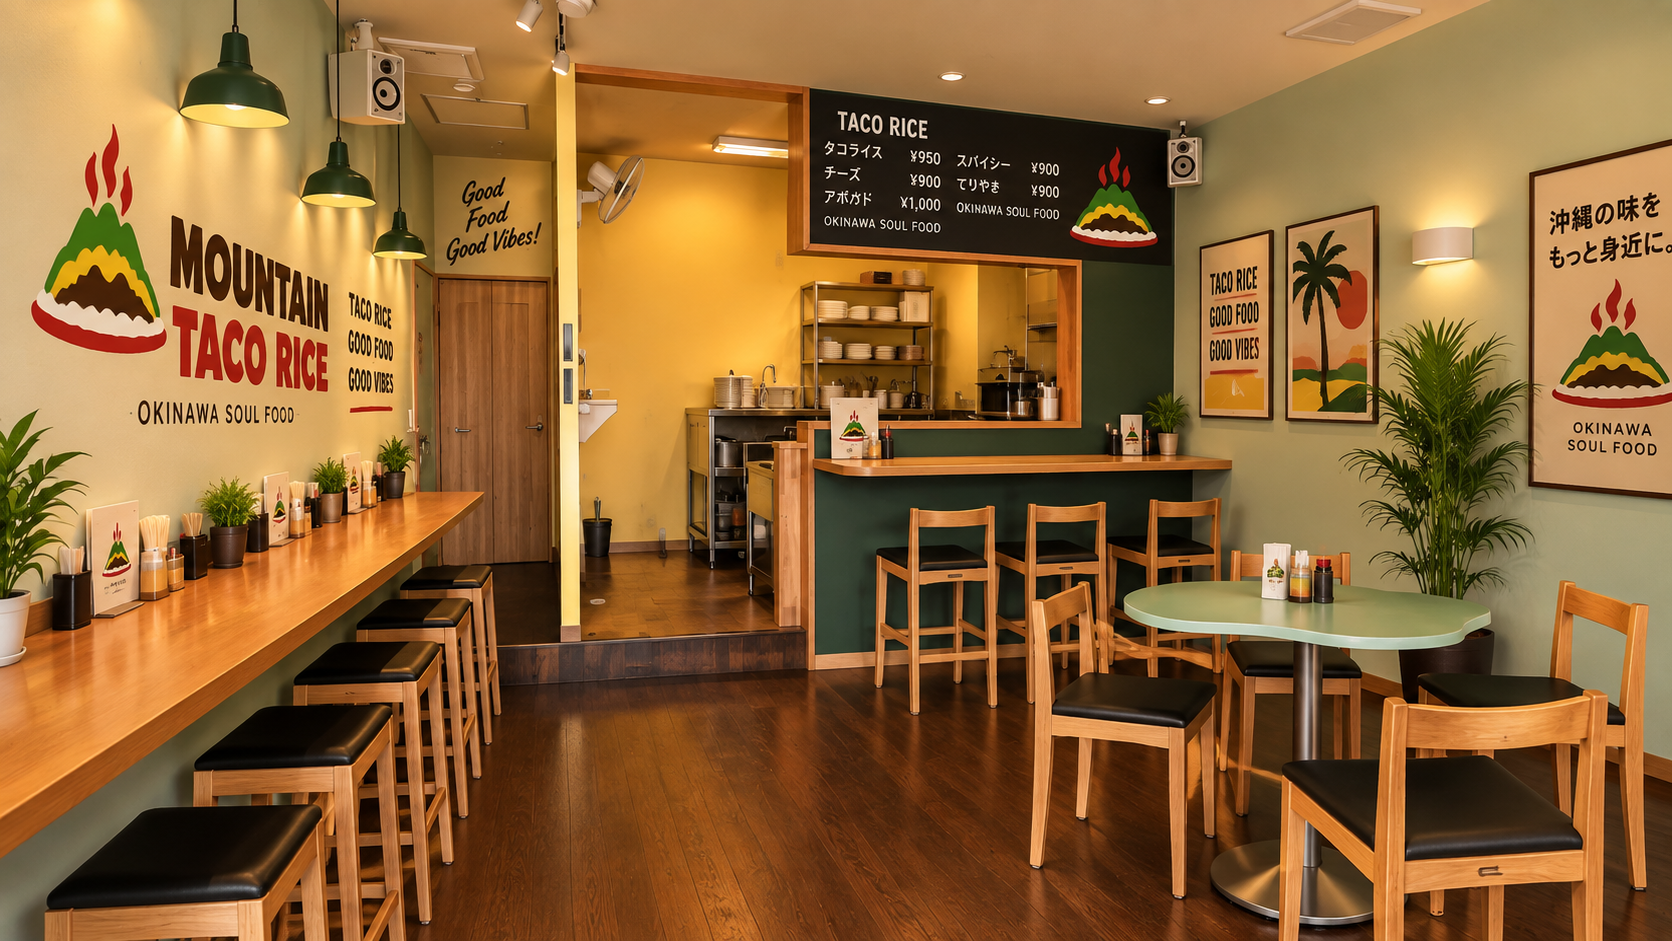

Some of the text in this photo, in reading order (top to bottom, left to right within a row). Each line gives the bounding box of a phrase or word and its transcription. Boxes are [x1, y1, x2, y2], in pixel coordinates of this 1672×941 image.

[837, 110, 929, 140] TACO RICE
[824, 140, 942, 166] タコライス ¥950
[824, 165, 942, 189] チーズ ¥900
[1030, 161, 1061, 177] ¥900
[461, 176, 506, 208] Good
[955, 177, 1061, 199] てりやき ¥900
[465, 200, 510, 234] Food
[899, 196, 942, 213] ¥1,000
[955, 201, 1061, 220] OKINAWA SOUL FOOD
[1549, 192, 1661, 236] 沖縄の味を
[823, 215, 942, 234] OKINAWA SOUL FOOD
[446, 221, 543, 267] Good Vibes!
[1549, 231, 1672, 270] もっと身近に。
[170, 215, 329, 332] MOUNTAIN
[1209, 265, 1258, 296] TACO RICE
[348, 291, 392, 330] TACO RICE
[1209, 301, 1260, 328] GOOD FOOD
[172, 304, 329, 393] TACO RICE
[348, 329, 373, 357] GOOD
[374, 336, 394, 362] FOOD
[1209, 336, 1260, 362] GOOD VIBES
[348, 366, 394, 394] GOOD VIBES
[137, 399, 295, 426] OKINAWA SOUL FOOD
[1567, 421, 1658, 456] OKINAWA SOUL FOOD
